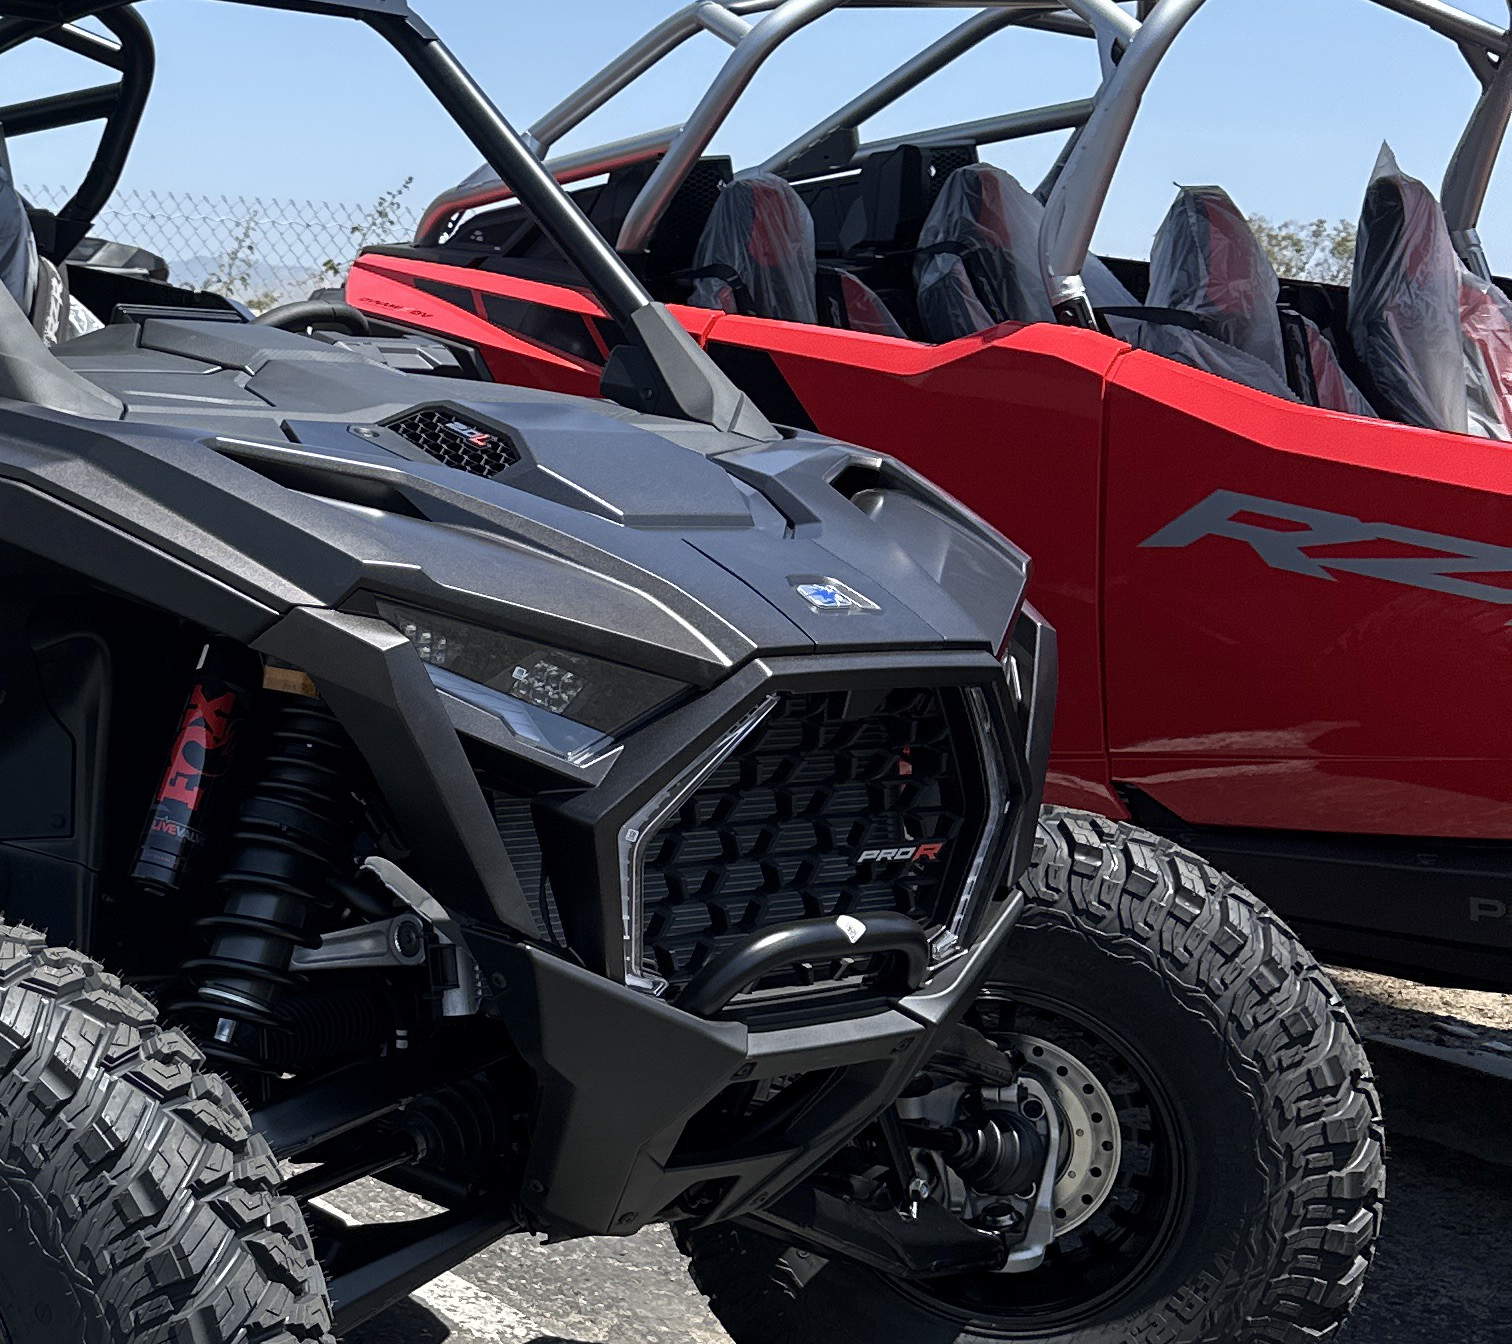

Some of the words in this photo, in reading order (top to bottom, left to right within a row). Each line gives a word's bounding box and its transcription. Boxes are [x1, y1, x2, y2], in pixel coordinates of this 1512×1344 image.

[1138, 488, 1512, 628] RZ
[157, 683, 237, 811] FOX
[1469, 896, 1512, 923] P
